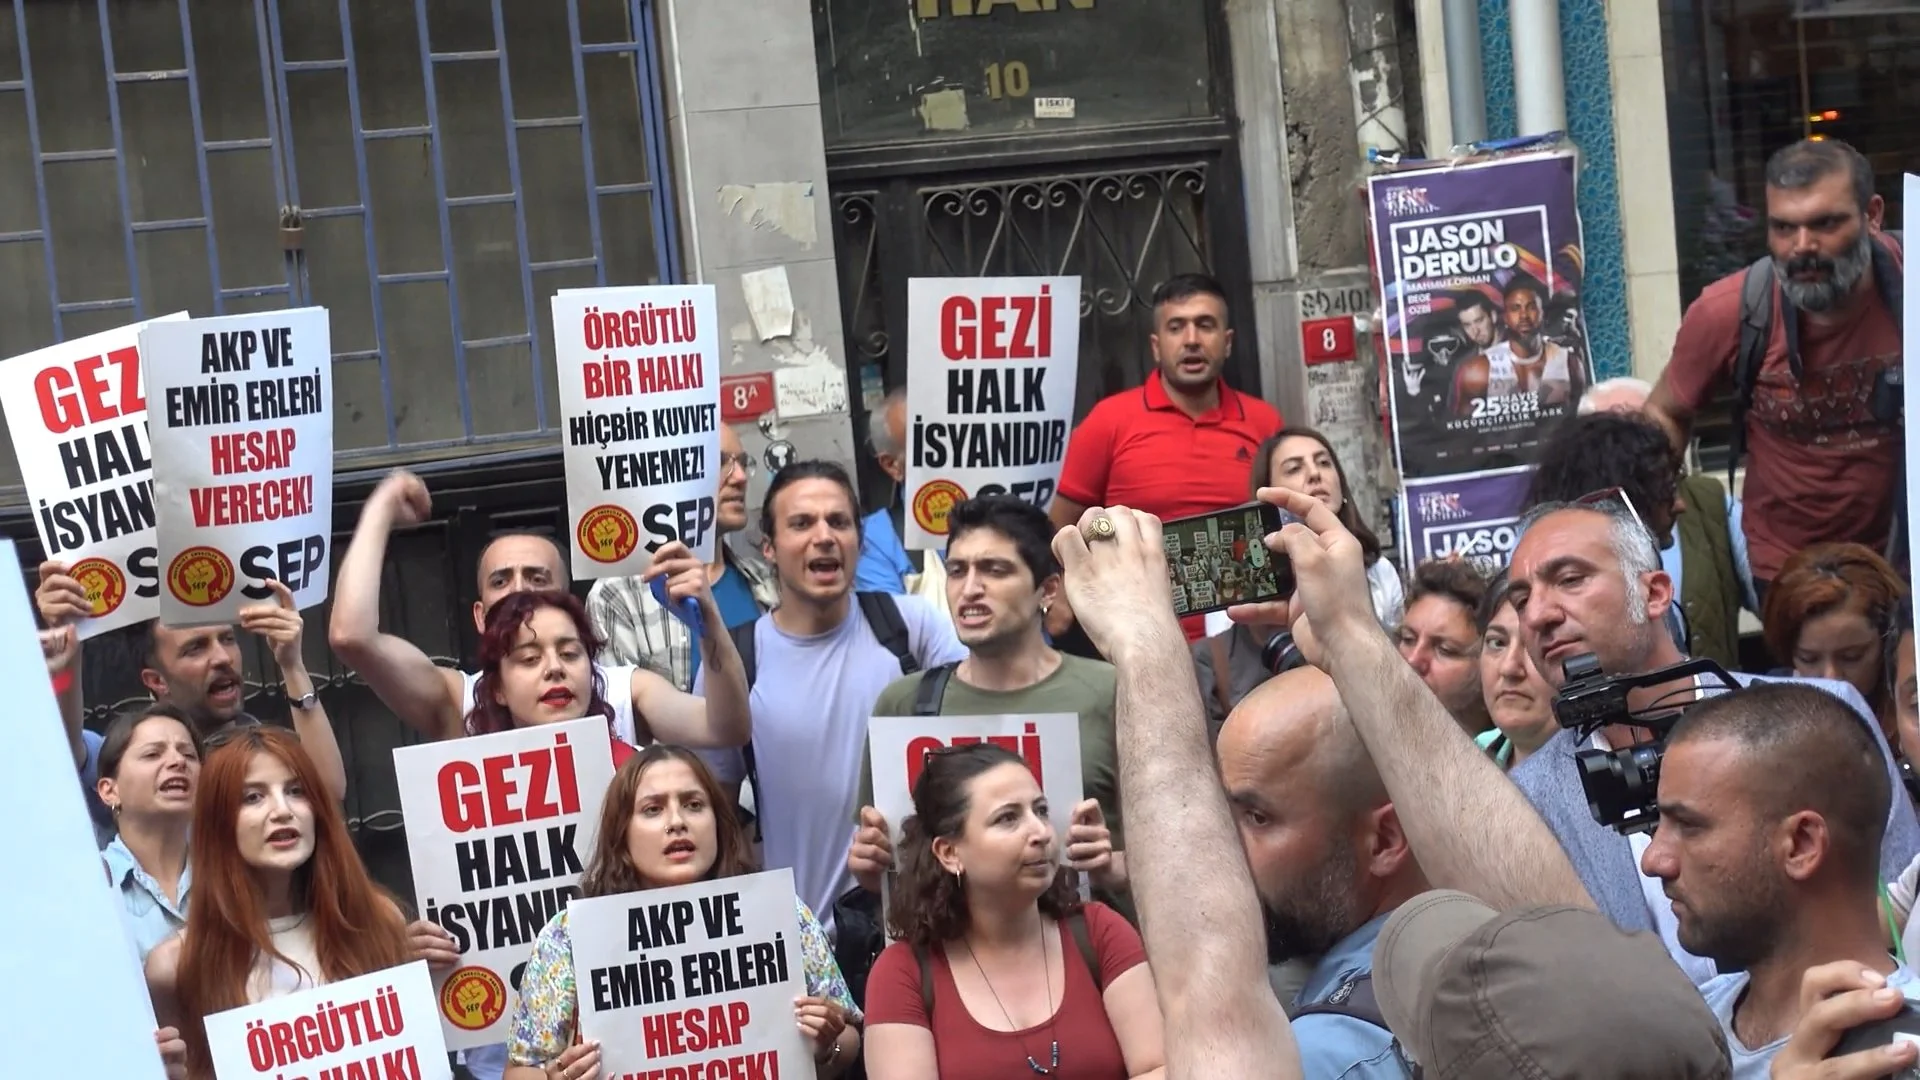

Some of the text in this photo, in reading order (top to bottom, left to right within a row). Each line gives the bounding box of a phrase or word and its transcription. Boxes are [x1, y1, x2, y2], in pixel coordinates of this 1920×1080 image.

[984, 61, 1030, 99] 10
[1401, 219, 1505, 254] JASON
[1402, 244, 1517, 280] DERULO
[584, 299, 697, 351] ÖRGÜTLÜ
[940, 284, 1052, 361] GEZİ
[1322, 328, 1336, 351] 8
[201, 327, 294, 374] AKP VE
[166, 367, 322, 428] EMİR ERLERİ
[583, 353, 703, 400] BİR HALKI
[734, 384, 758, 409] 8A
[947, 367, 1047, 414] HALK
[570, 406, 648, 450] HİÇBİR
[654, 403, 716, 439] KUVVET
[1470, 390, 1538, 418] 25 MAYIS
[1502, 400, 1539, 415] 2022
[1535, 407, 1563, 418] PARK
[58, 421, 152, 489] HAL
[211, 428, 296, 476] HESAP
[913, 415, 1066, 468] İSYANIDIR
[596, 446, 705, 491] YENEMEZ!
[40, 479, 156, 554] İSYAN
[190, 475, 313, 527] VERECEK!
[643, 496, 715, 555] SEP
[1434, 526, 1520, 558] JASO
[240, 535, 326, 600] SEP
[437, 732, 581, 833] GEZİ
[455, 824, 584, 892] HALK
[628, 892, 744, 951] AKP VE
[591, 953, 676, 1012] EMİR
[681, 932, 789, 998] ERLERİ
[246, 985, 404, 1072] ÖRGÜTLÜ
[642, 1002, 750, 1060] HESAP
